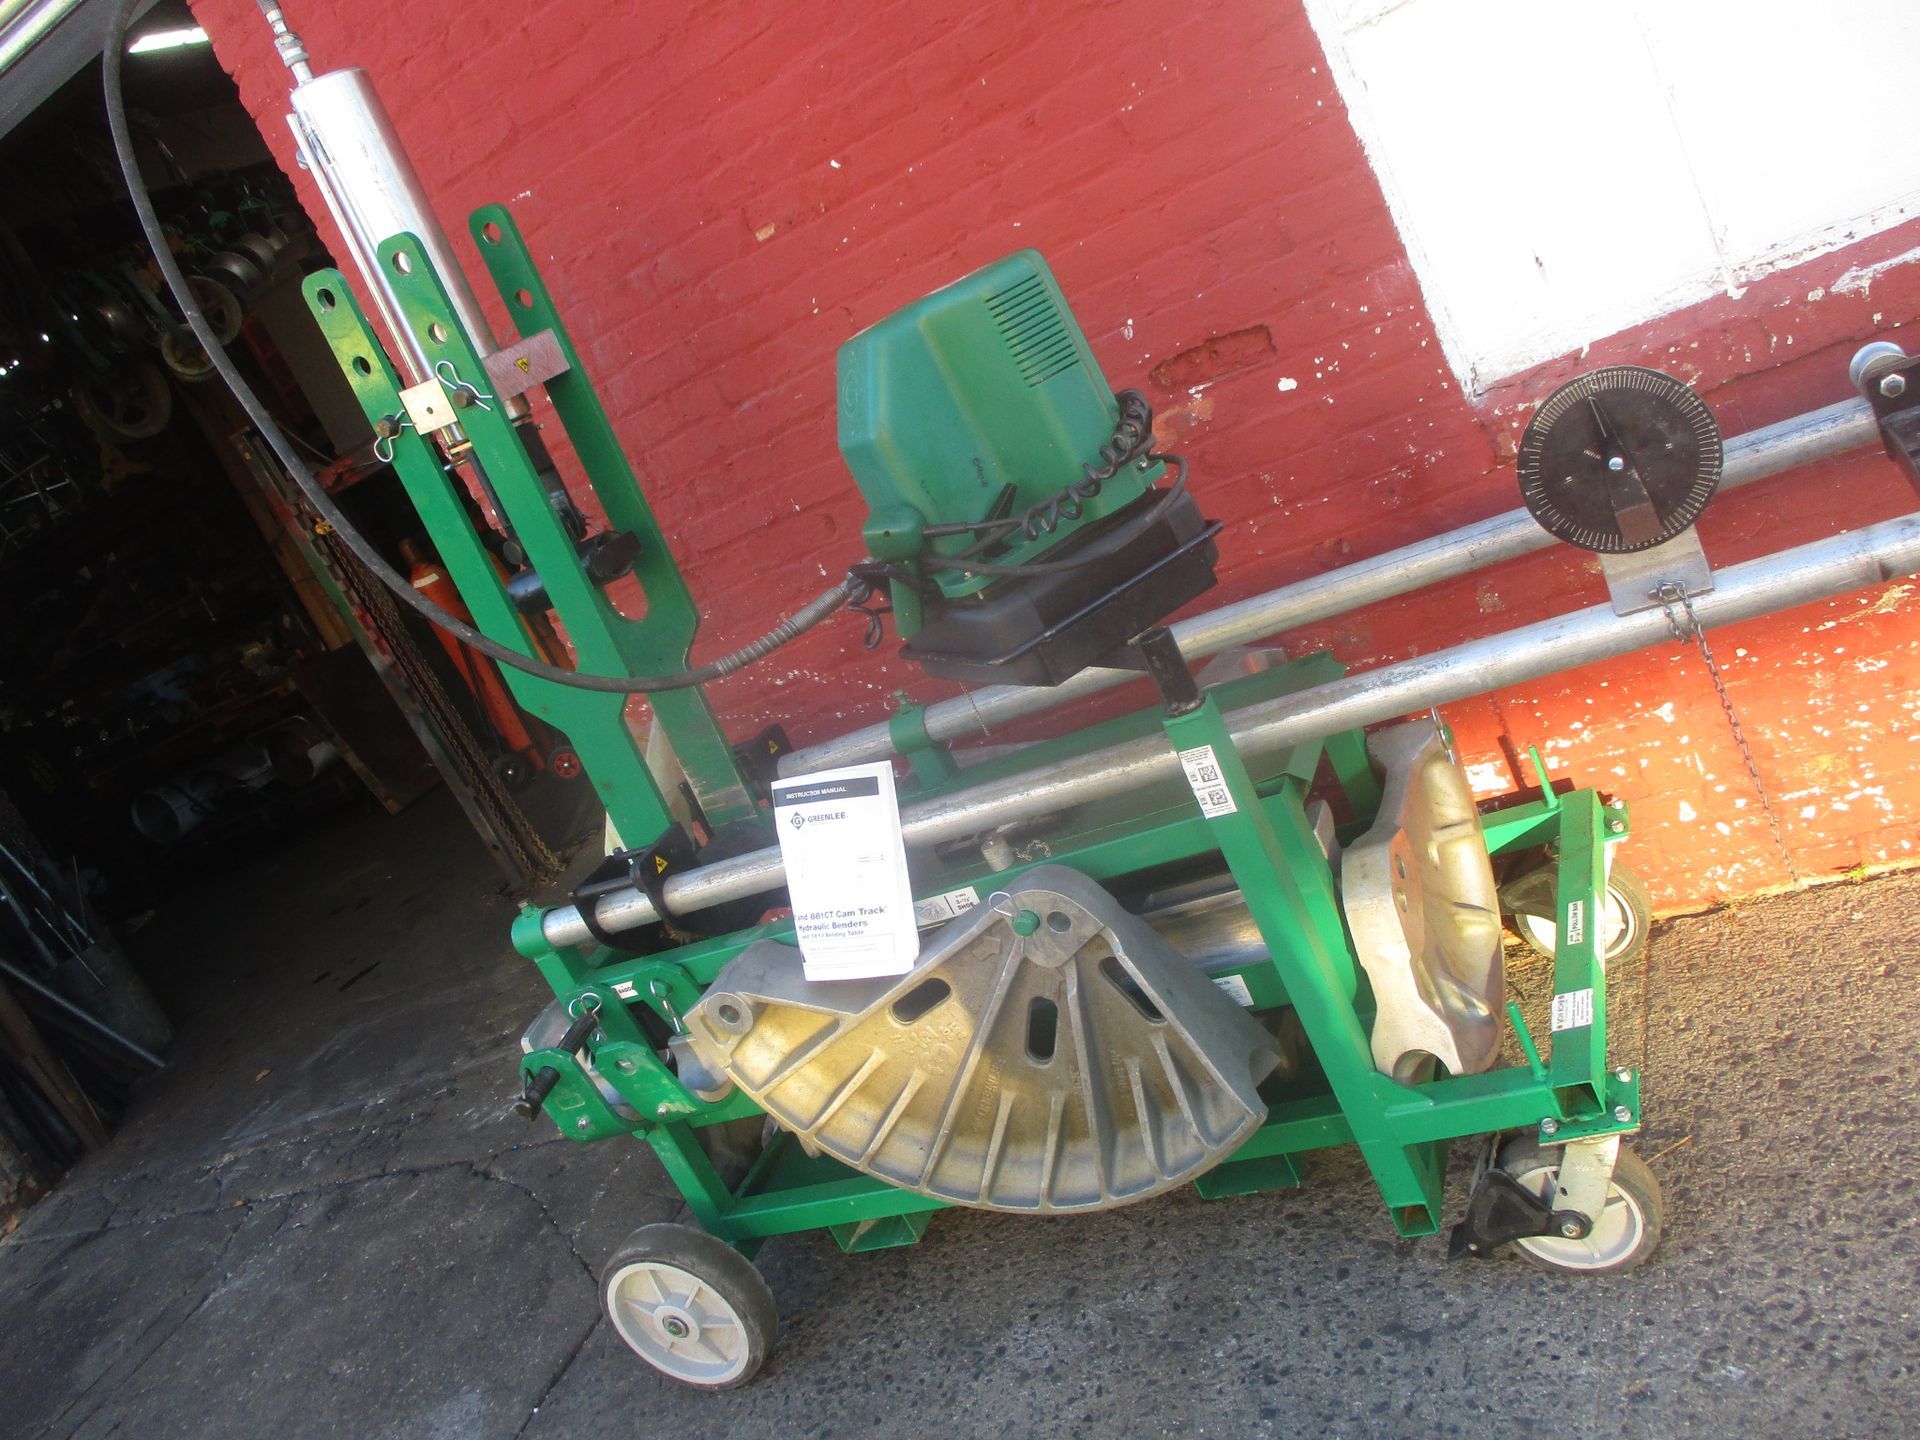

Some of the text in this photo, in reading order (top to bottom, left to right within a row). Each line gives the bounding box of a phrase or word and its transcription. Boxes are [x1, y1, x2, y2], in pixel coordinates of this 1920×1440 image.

[785, 786, 847, 799] INSTRUCTION MANUAL
[807, 811, 846, 823] GREENLEE
[835, 909, 856, 918] Cam
[858, 906, 885, 916] Track
[831, 920, 868, 930] Benders
